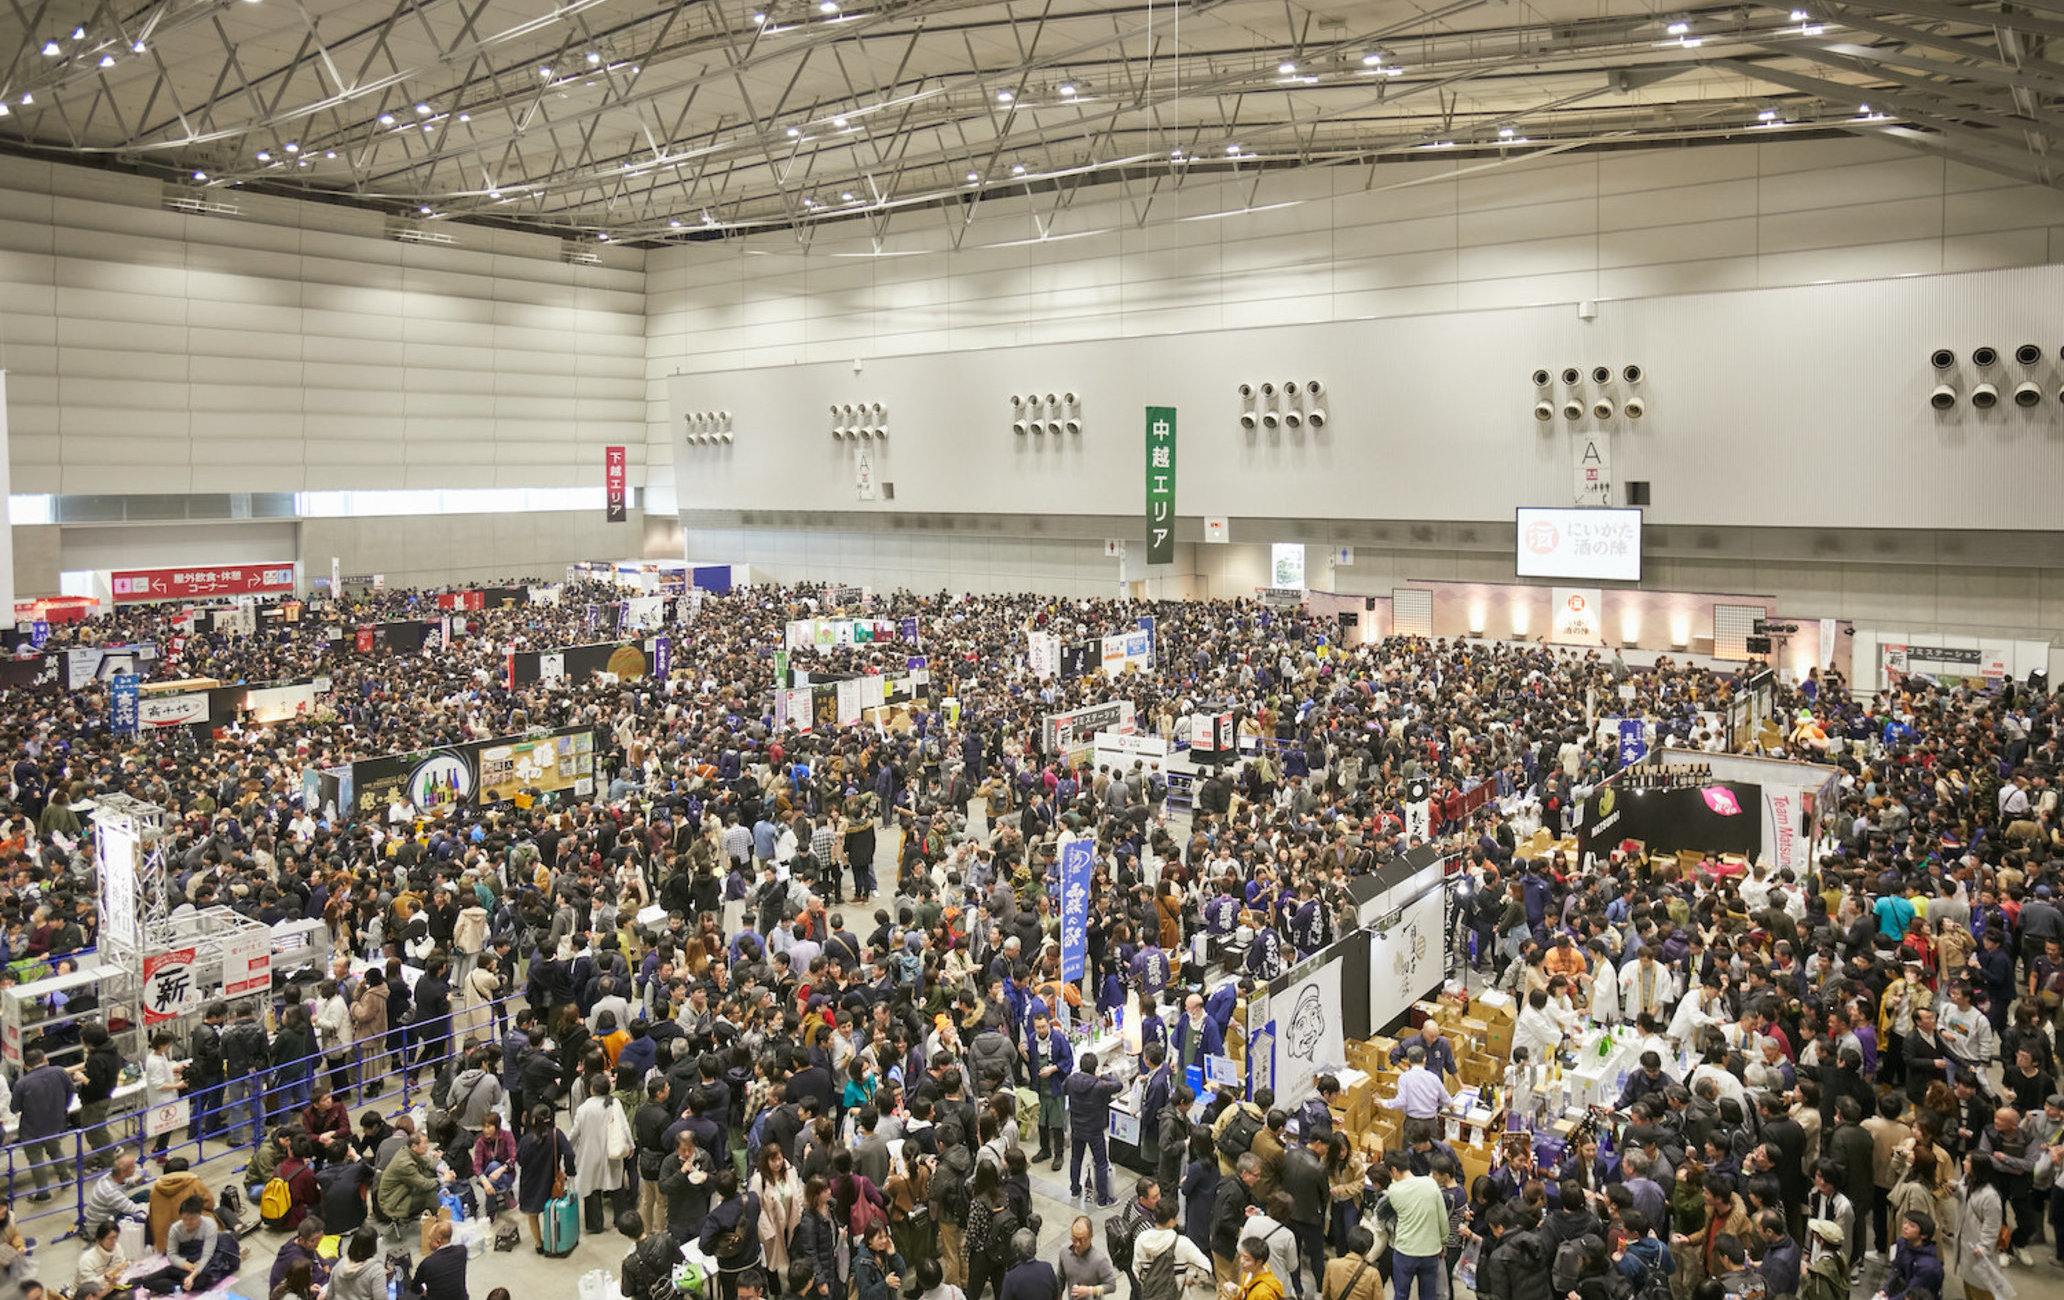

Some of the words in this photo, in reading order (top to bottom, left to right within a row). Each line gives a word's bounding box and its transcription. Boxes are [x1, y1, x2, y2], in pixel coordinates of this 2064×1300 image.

[1582, 442, 1601, 464] A
[609, 452, 622, 515] 下越エリア
[1152, 419, 1170, 548] 中越エリア
[1567, 521, 1634, 538] にいがた
[1574, 538, 1627, 556] 酒の陣
[173, 571, 242, 583] 屋外飲食・休憩
[188, 583, 229, 593] コーナー
[1774, 795, 1790, 824] Team
